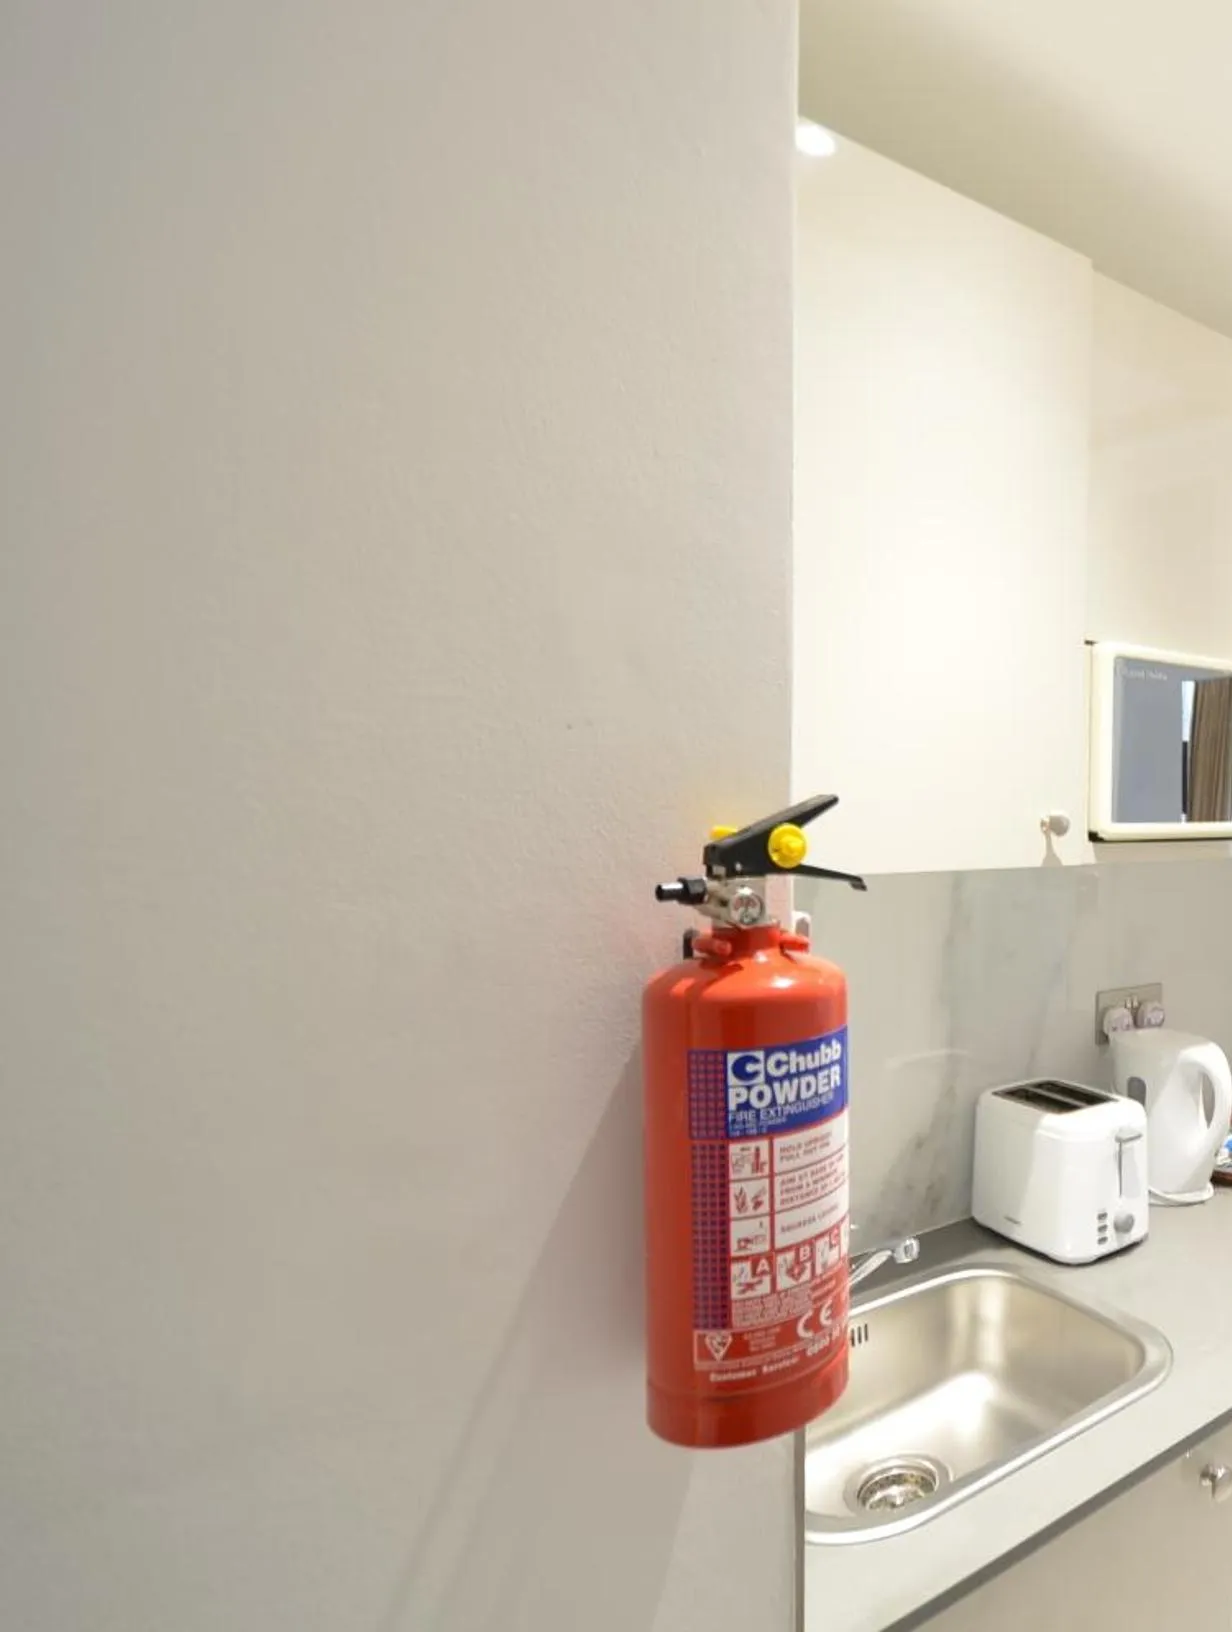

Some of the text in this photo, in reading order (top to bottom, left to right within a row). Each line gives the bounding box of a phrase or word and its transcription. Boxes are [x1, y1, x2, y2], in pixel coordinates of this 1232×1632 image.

[767, 1038, 842, 1077] Chubb
[728, 1063, 841, 1111] POWDER
[728, 1109, 757, 1124] FIRE
[759, 1090, 834, 1122] EXTINGUISHER
[756, 1258, 770, 1275] A
[799, 1245, 811, 1261] B
